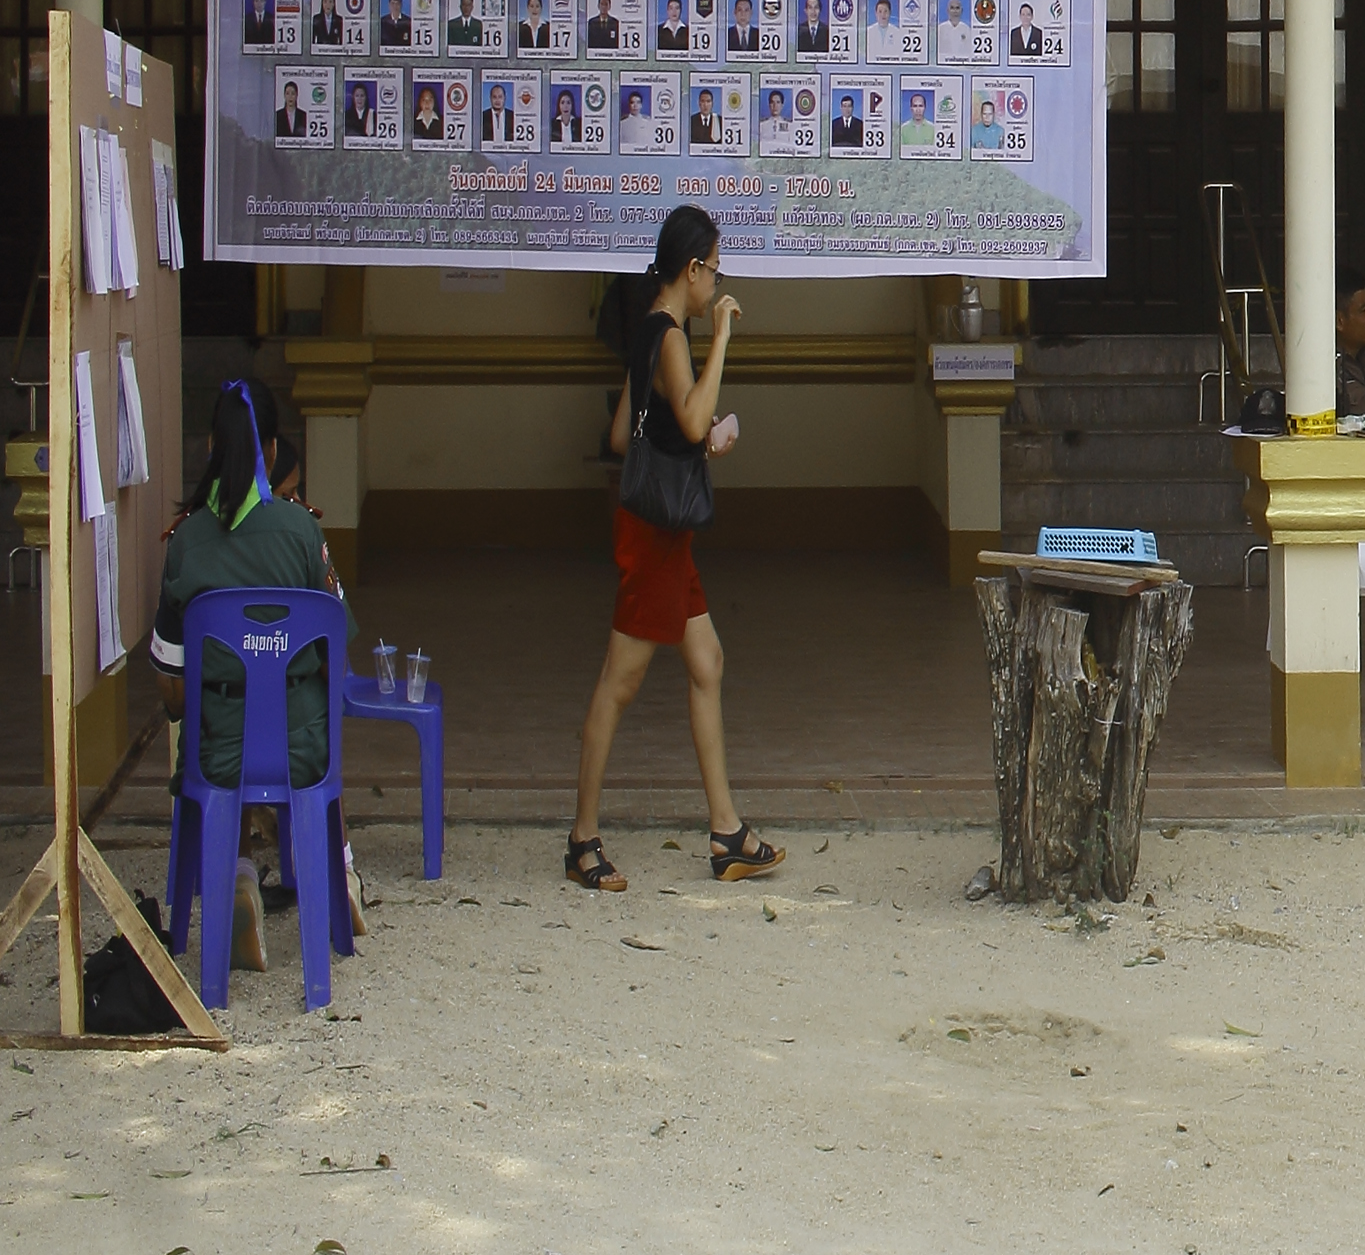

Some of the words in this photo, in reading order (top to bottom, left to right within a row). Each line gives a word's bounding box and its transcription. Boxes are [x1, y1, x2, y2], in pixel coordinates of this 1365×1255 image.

[278, 27, 295, 43] 13
[346, 28, 364, 44] 14
[415, 29, 432, 45] 15
[484, 30, 502, 46] 16
[553, 31, 571, 47] 17
[622, 32, 640, 48] 18
[692, 33, 710, 50] 19
[761, 34, 781, 50] 20
[832, 36, 850, 52] 21
[902, 36, 921, 53] 22
[973, 37, 992, 53] 23
[1044, 38, 1063, 54] 24
[310, 122, 328, 138] 25
[378, 122, 397, 139] 26
[447, 124, 465, 140] 27
[516, 125, 534, 141] 28
[585, 126, 604, 142] 29
[655, 127, 674, 143] 30
[725, 128, 743, 145] 31
[795, 130, 814, 146] 32
[865, 131, 885, 147] 33
[936, 132, 955, 148] 34
[1007, 133, 1026, 149] 35
[449, 160, 528, 192] วันอาทิตย์ที่
[535, 173, 556, 192] 24
[562, 166, 613, 193] มีนาคม
[620, 175, 662, 193] 2562
[676, 176, 709, 194] เวลา
[716, 176, 763, 195] 08.00
[785, 177, 831, 196] 17.00
[838, 180, 855, 198] น.
[247, 192, 485, 222] ติดต่อสอบถามข้อมูลเกี่ยวกับการเลือกตั้งได้ที่
[574, 207, 584, 222] 2
[589, 200, 613, 222] โทร.
[782, 204, 845, 226] แก้วบัวทอง
[926, 211, 940, 230] 2)
[946, 208, 971, 229] โทร.
[977, 213, 1065, 230] 081-8938825
[431, 226, 449, 242] โทร.
[957, 237, 975, 254] โทร.
[980, 240, 1048, 255] 092-2602937
[243, 630, 289, 658] สมุยกรุ๊ป
